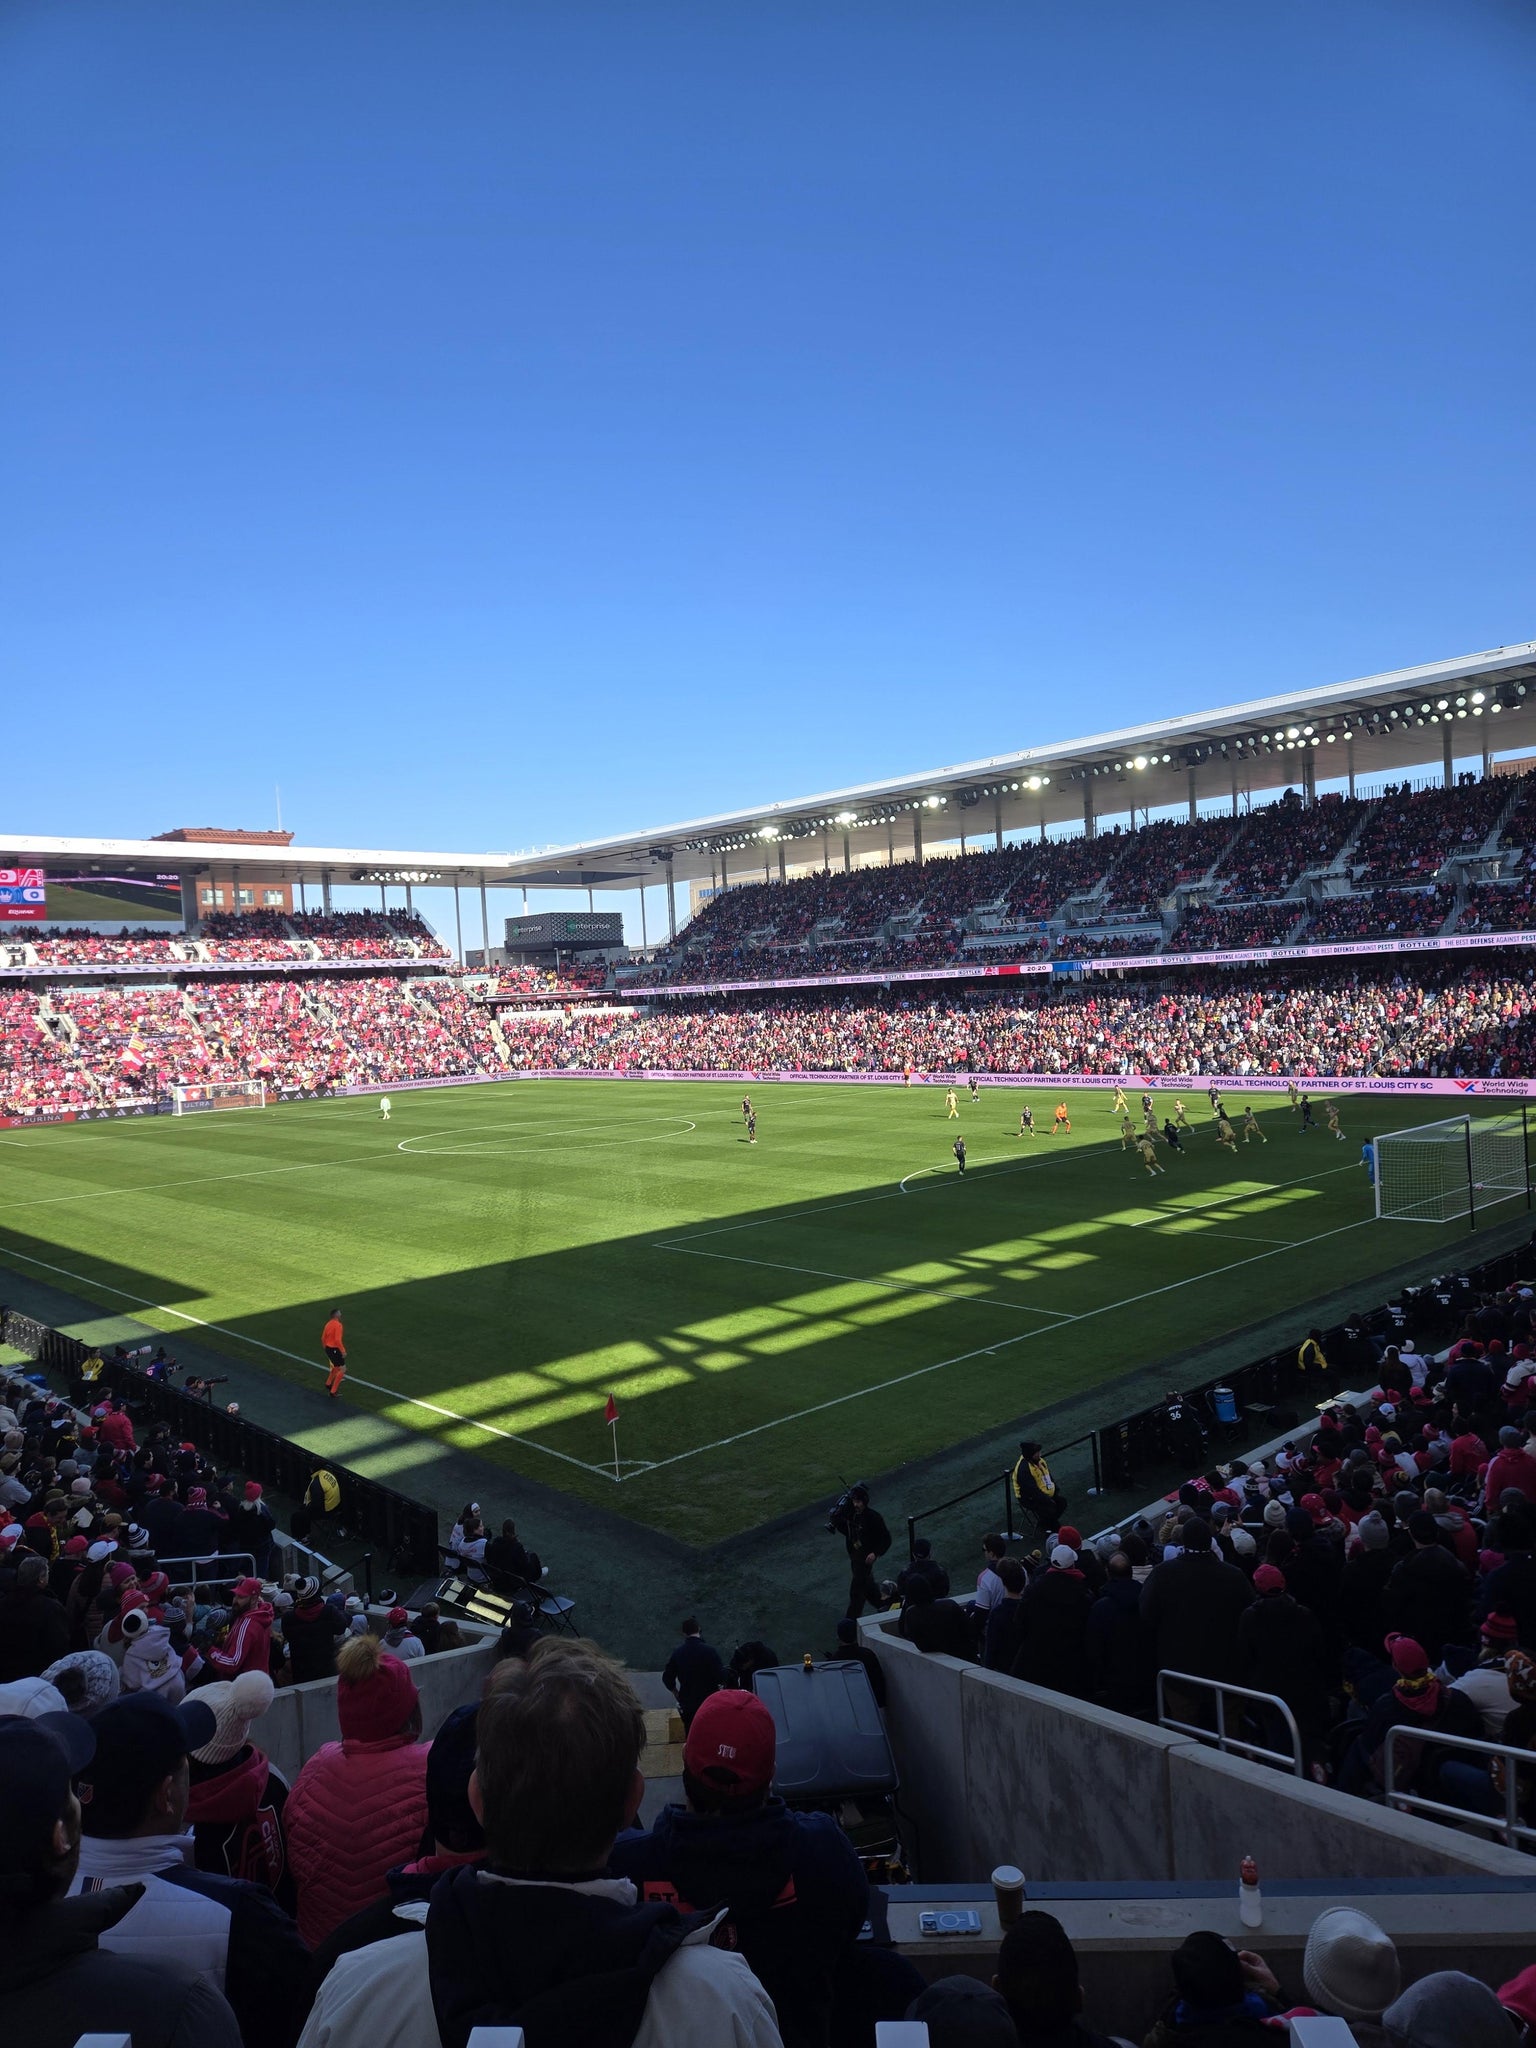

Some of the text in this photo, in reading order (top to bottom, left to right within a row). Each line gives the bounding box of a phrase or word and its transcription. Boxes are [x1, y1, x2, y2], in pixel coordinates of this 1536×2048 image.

[567, 922, 610, 931] enterprise
[23, 1115, 60, 1123] PURINA
[1170, 1411, 1182, 1421] 36
[262, 1820, 278, 1867] CITY
